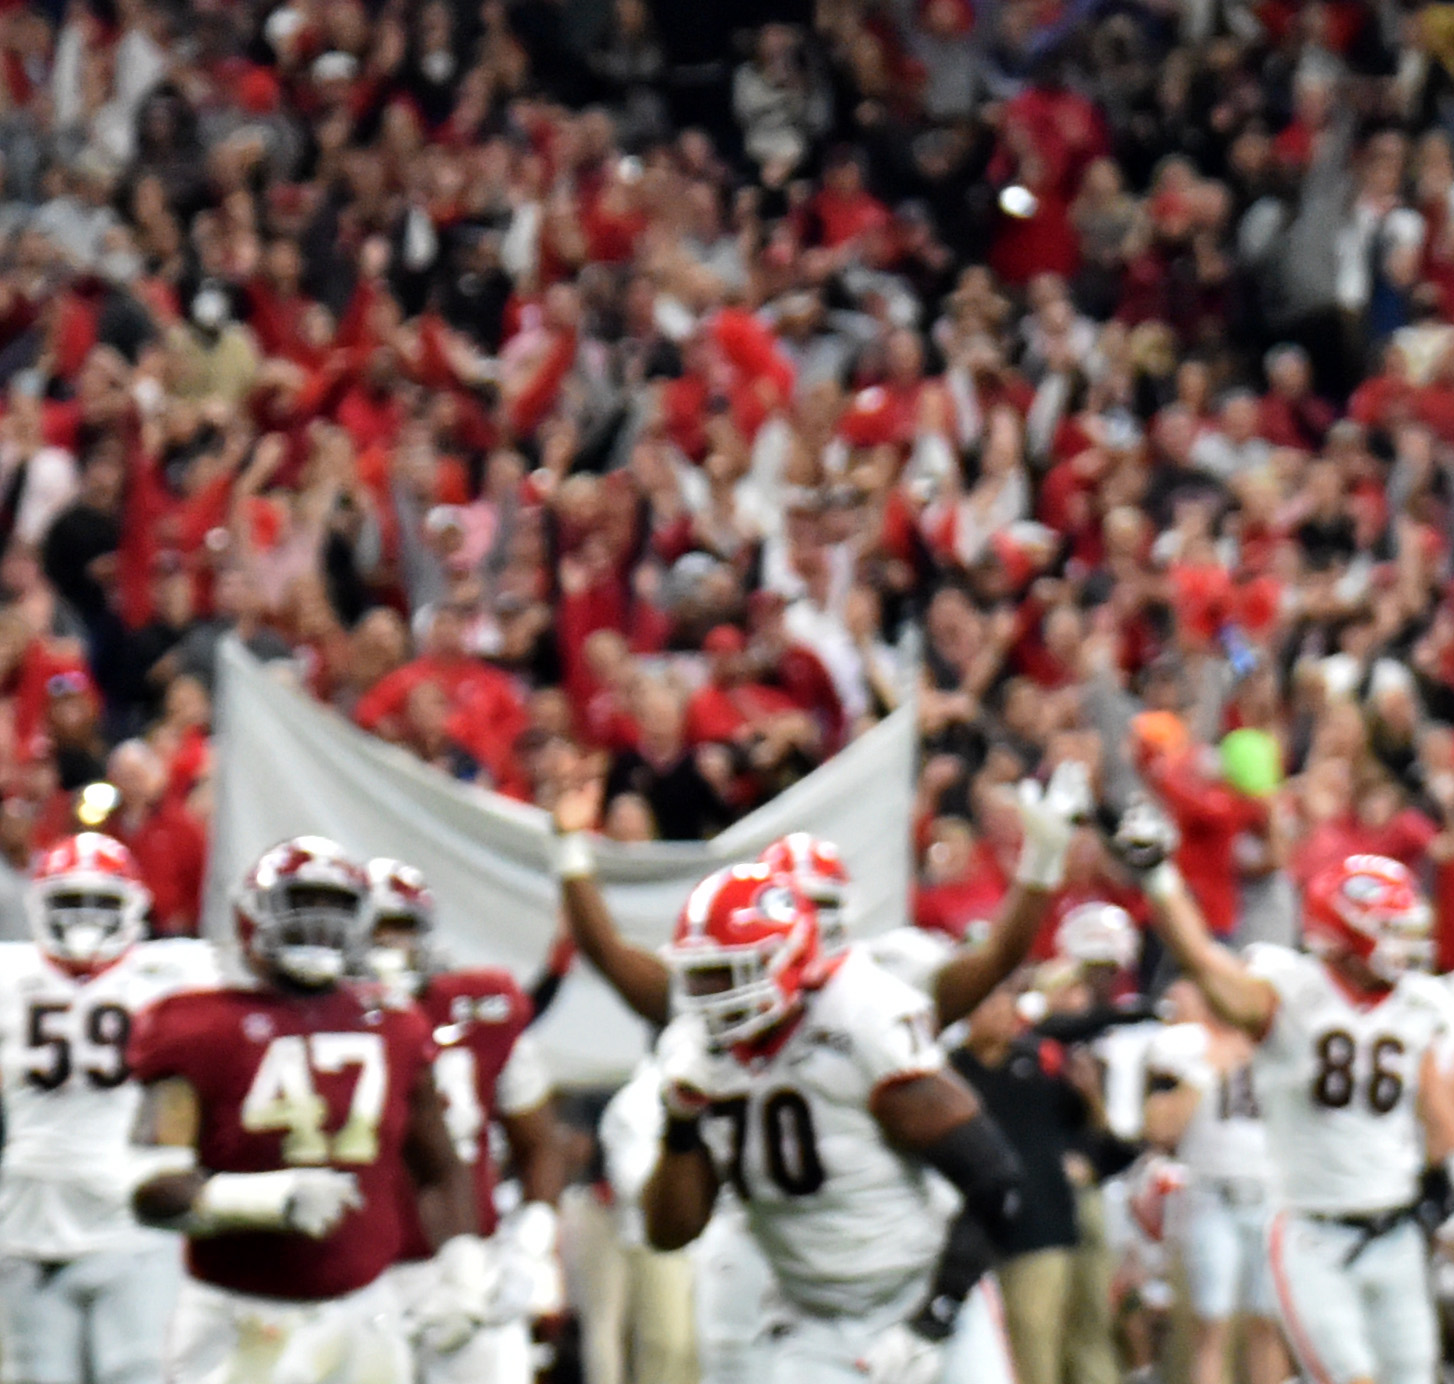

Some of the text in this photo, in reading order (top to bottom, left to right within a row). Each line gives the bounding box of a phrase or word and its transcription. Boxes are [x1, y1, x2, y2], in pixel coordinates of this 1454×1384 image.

[25, 1002, 133, 1088] 59
[1313, 1029, 1403, 1113] 86
[240, 1031, 388, 1163] 47
[702, 1086, 826, 1202] 70
